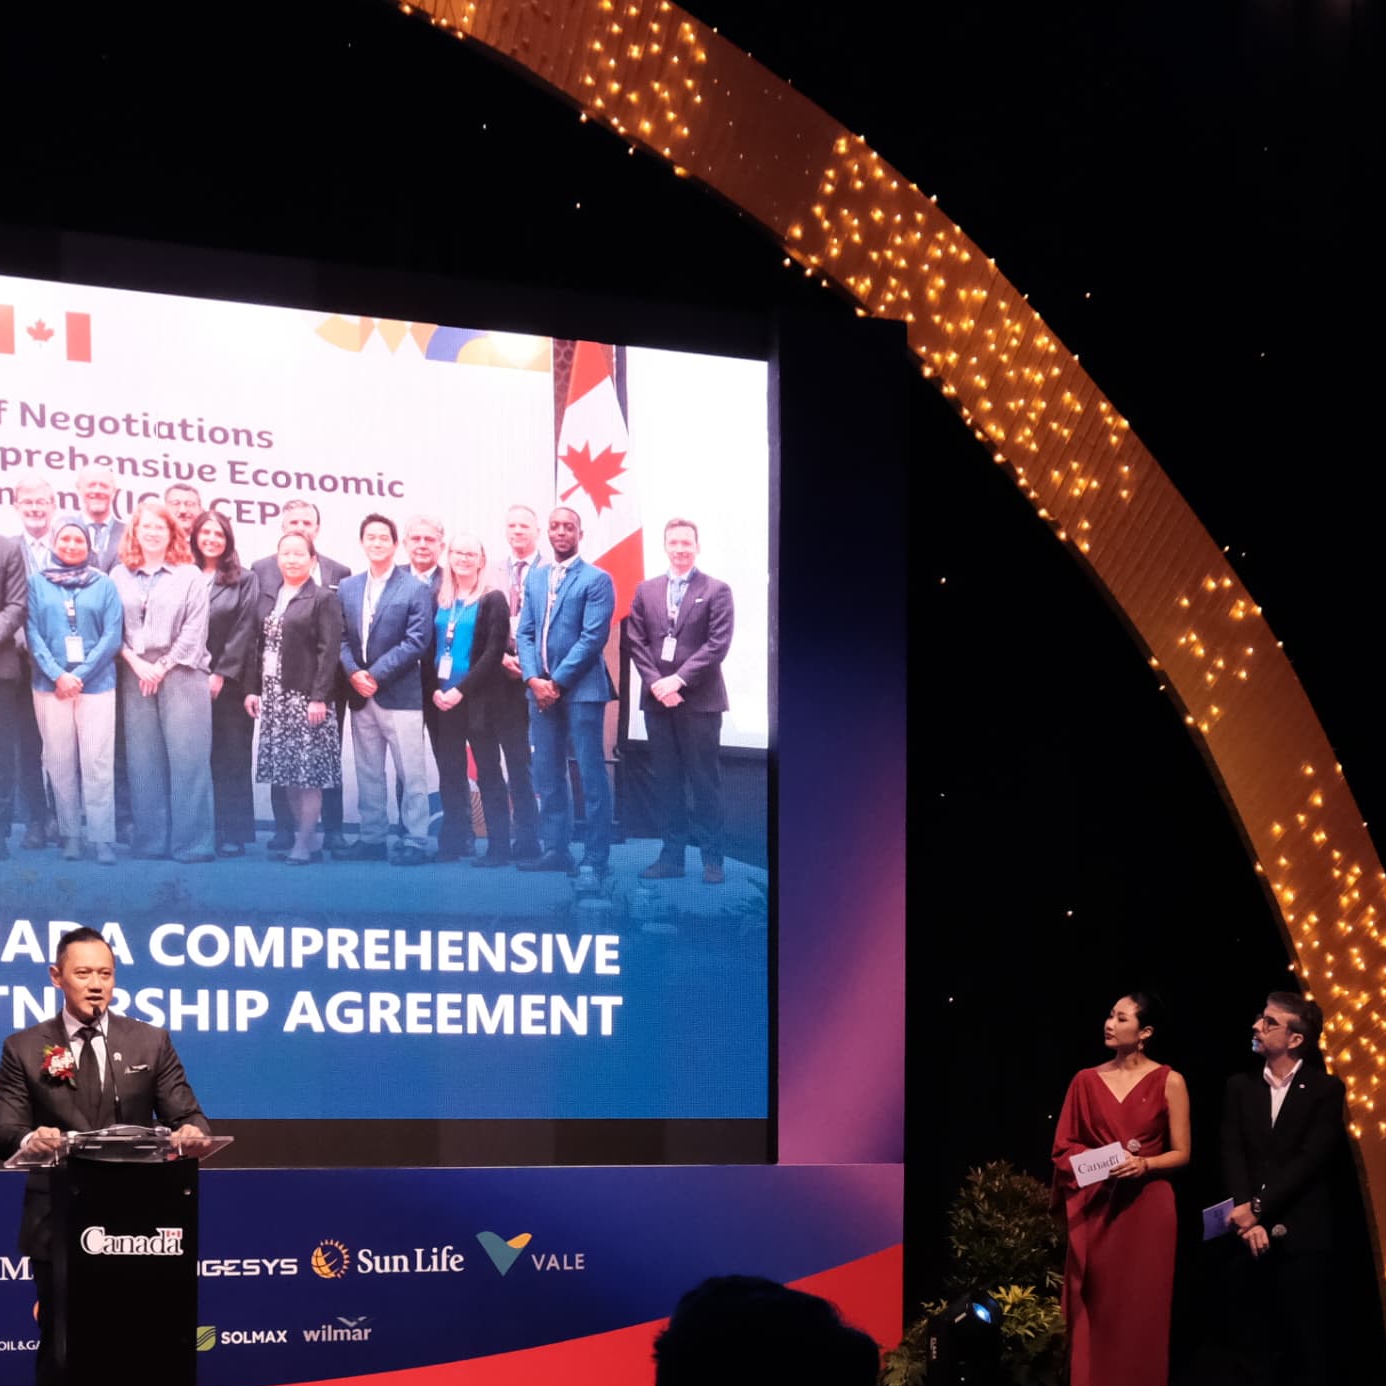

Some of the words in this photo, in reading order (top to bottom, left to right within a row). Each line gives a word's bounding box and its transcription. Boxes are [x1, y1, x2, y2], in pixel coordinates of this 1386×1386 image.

[19, 400, 274, 449] Negotiations
[228, 459, 405, 499] Economic
[149, 922, 622, 976] COMPREHENSIVE
[284, 990, 623, 1037] AGREEMENT
[80, 1226, 185, 1256] Canada
[197, 1259, 298, 1276] GESYS
[357, 1248, 411, 1274] Sun
[413, 1245, 465, 1273] Life
[531, 1254, 586, 1271] VALE
[221, 1330, 288, 1344] SOLMAX
[303, 1325, 372, 1343] wilmar
